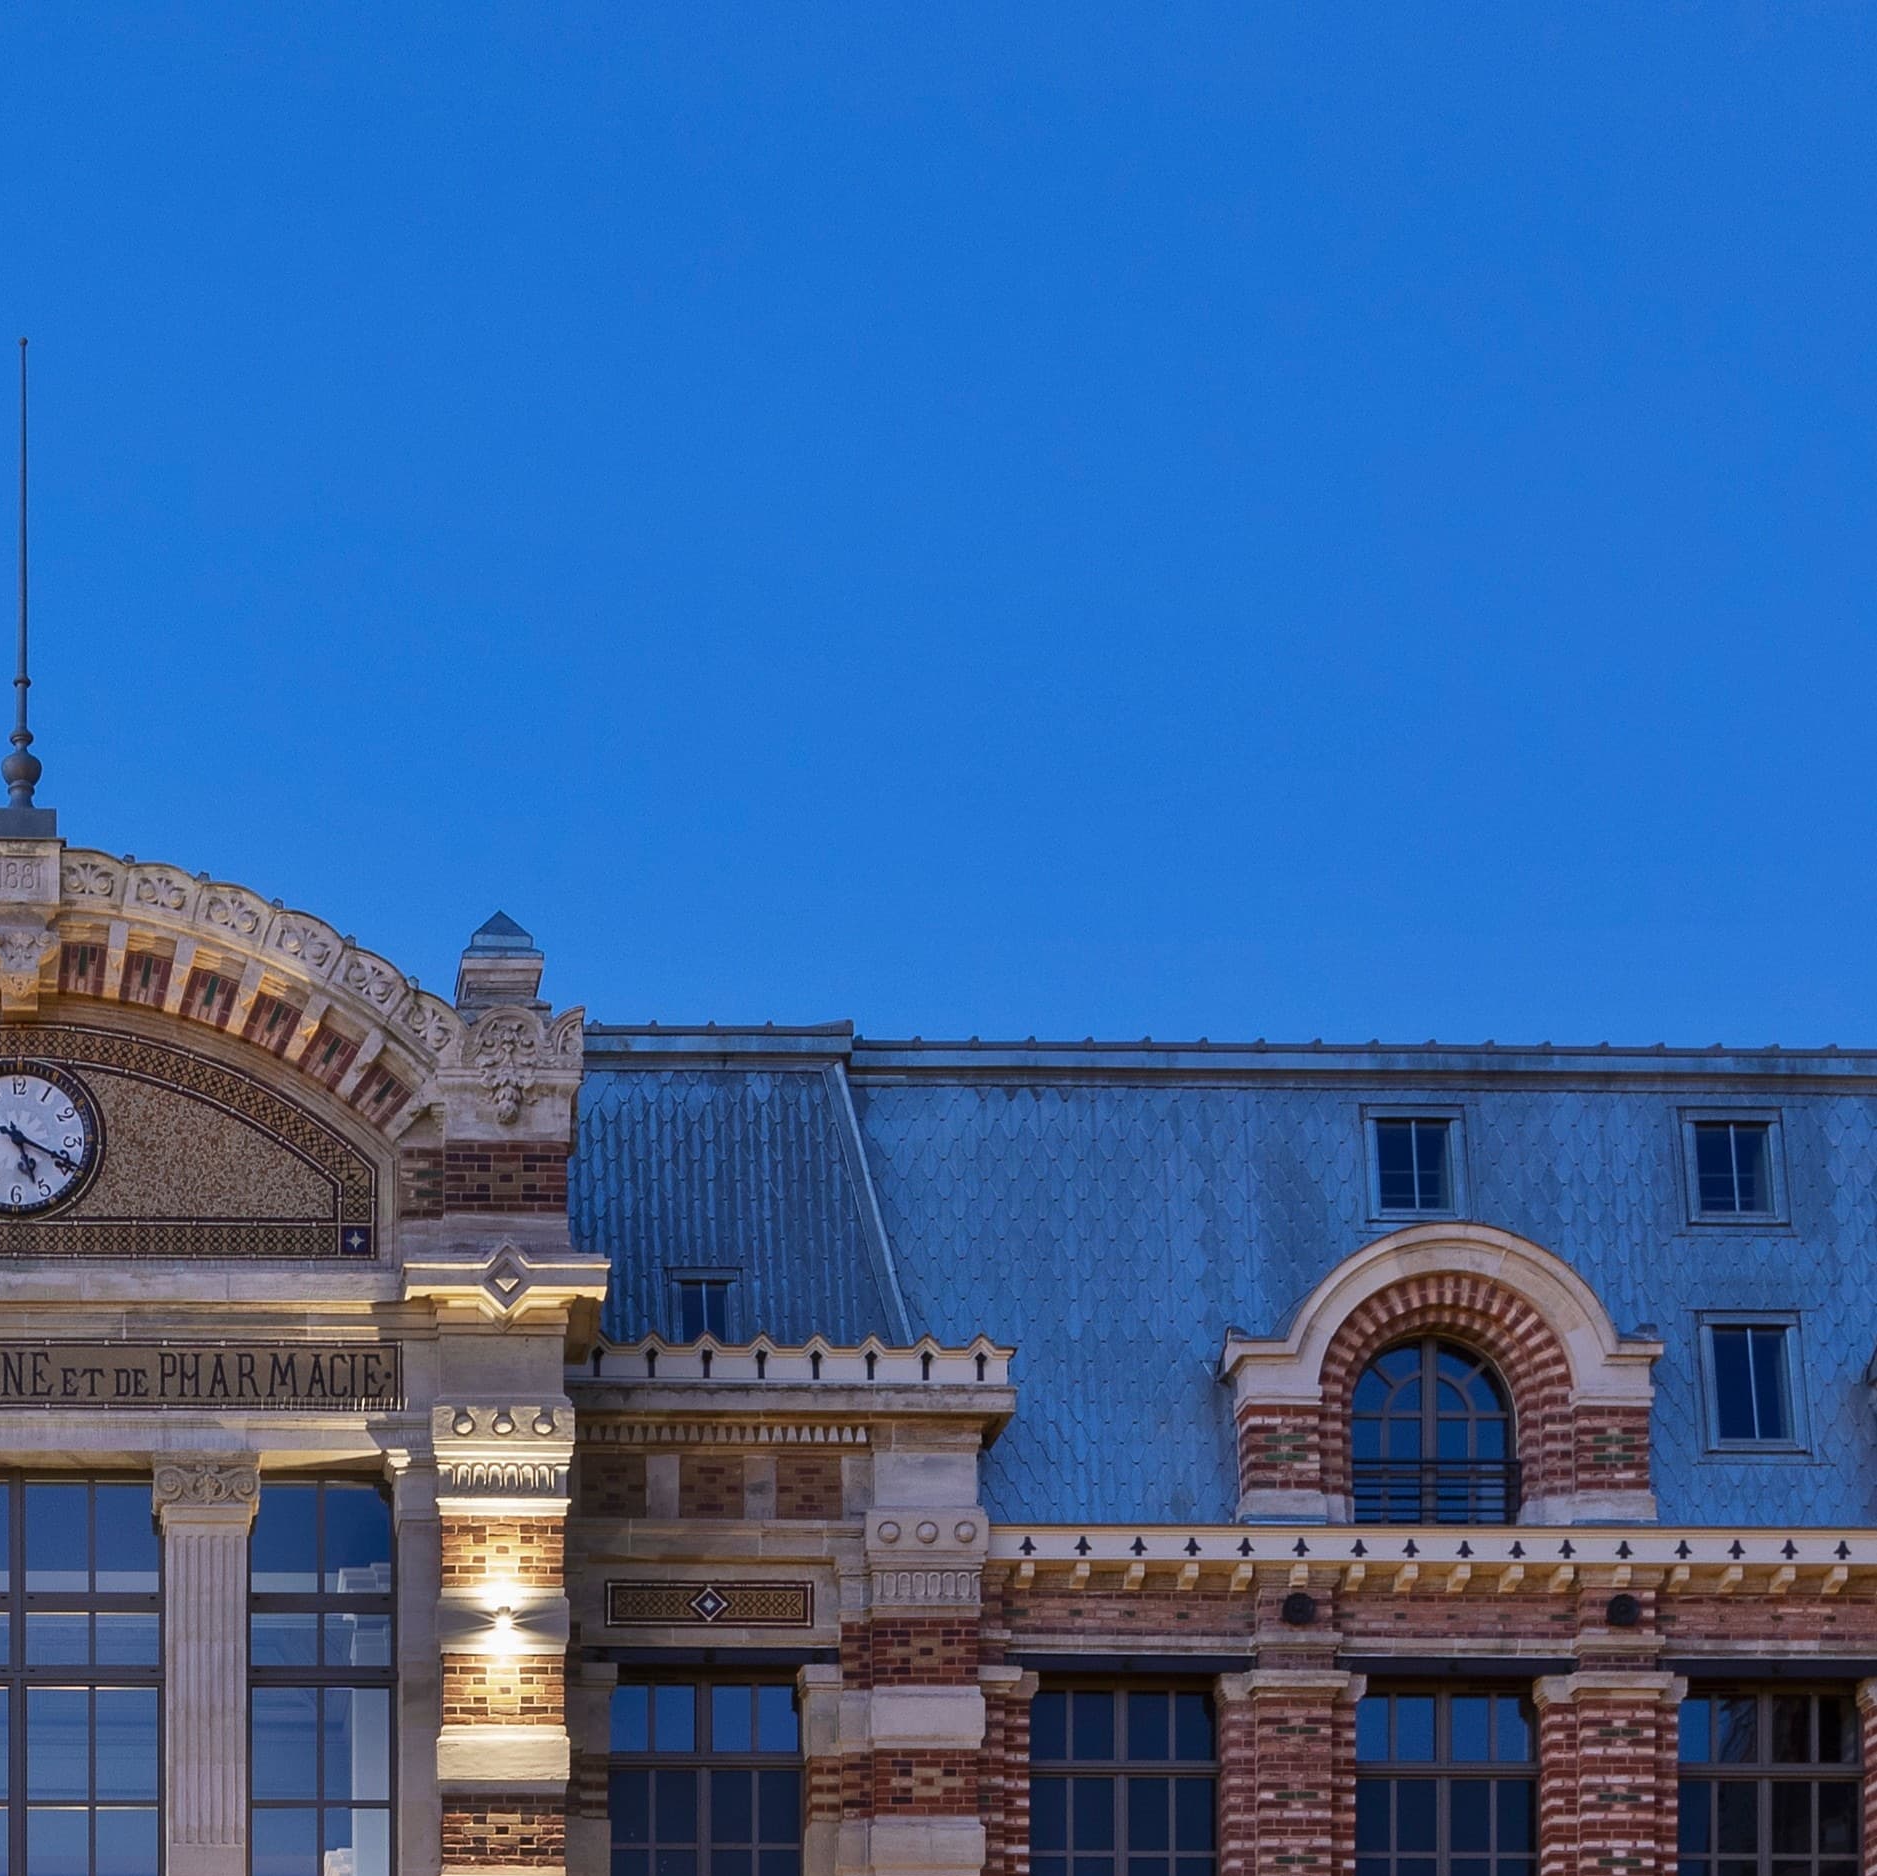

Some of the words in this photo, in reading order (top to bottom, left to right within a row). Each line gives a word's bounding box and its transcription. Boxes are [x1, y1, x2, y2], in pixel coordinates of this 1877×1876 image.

[12, 1077, 27, 1096] 12
[40, 1086, 53, 1103] 1
[56, 1106, 75, 1122] 2
[63, 1135, 83, 1148] 3
[10, 1185, 22, 1204] 6
[38, 1178, 52, 1198] 5
[60, 1367, 105, 1397] ET
[158, 1352, 386, 1399] PHARMACIE
